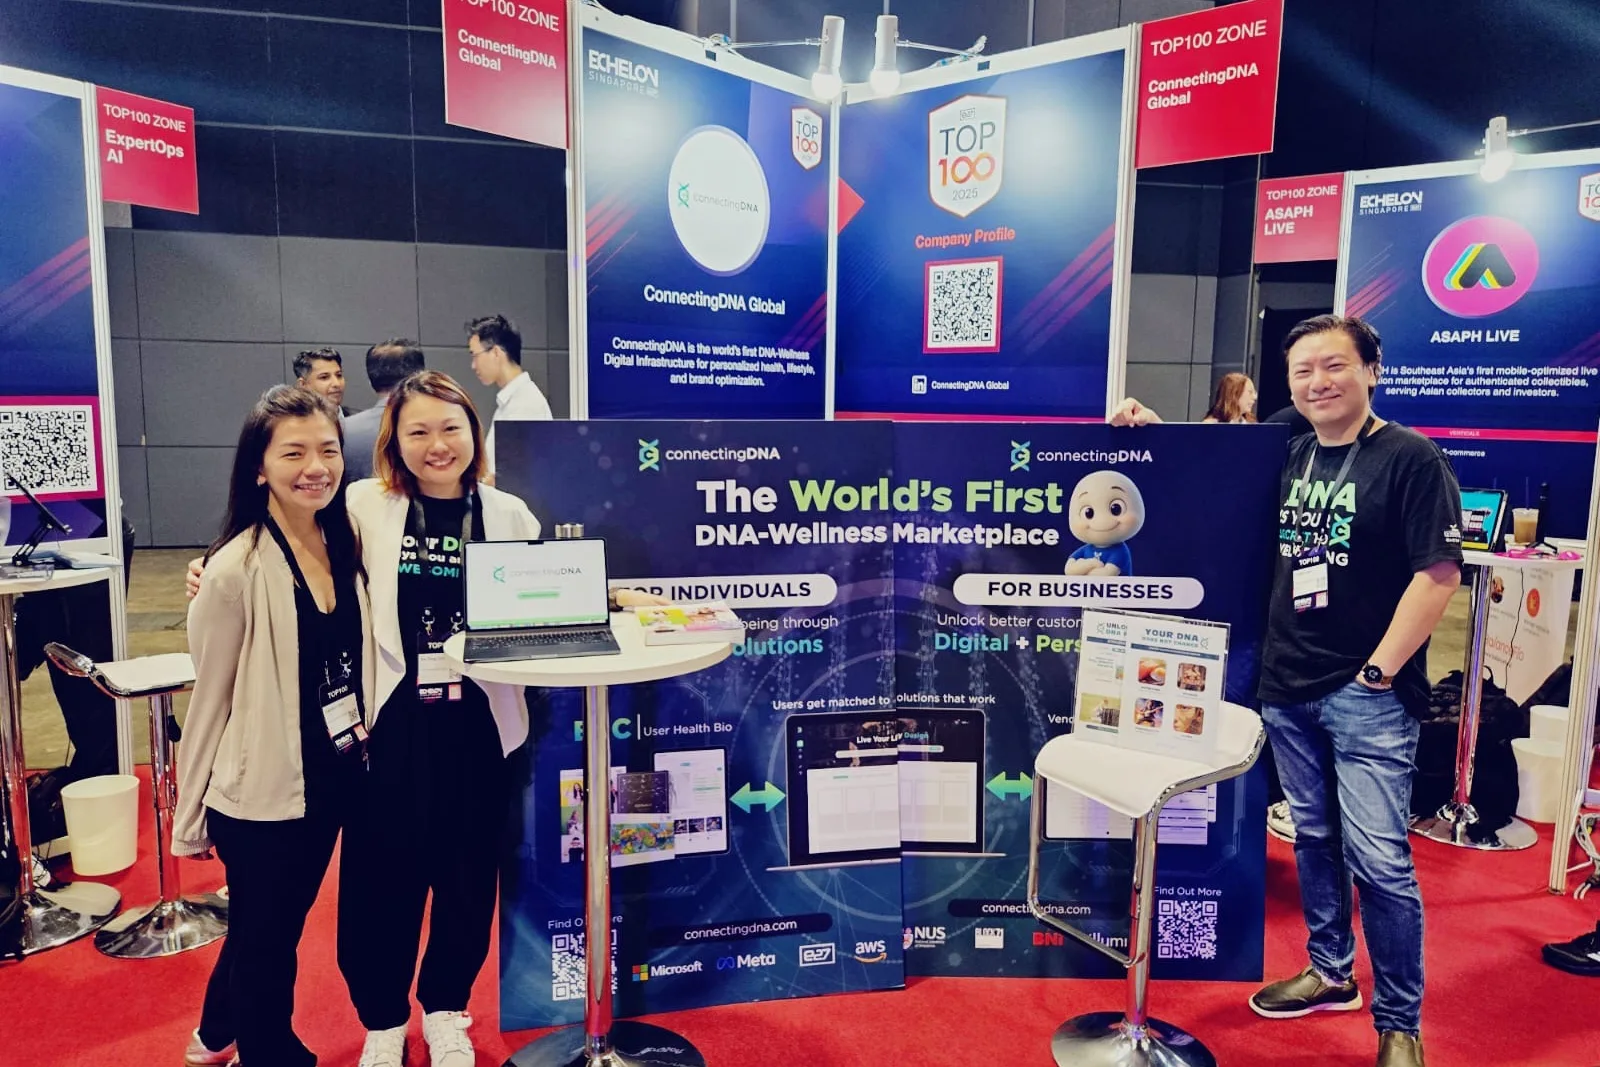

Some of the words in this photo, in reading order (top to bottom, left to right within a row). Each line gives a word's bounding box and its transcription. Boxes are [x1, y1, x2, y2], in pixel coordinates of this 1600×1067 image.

[518, 4, 560, 32] ZONE
[1150, 31, 1212, 56] TOP100
[1215, 19, 1267, 44] ZONE
[458, 28, 557, 70] ConnectingDNA
[459, 48, 501, 71] Global
[588, 49, 659, 88] ECHELON
[1148, 62, 1259, 93] ConnectingDNA
[1147, 91, 1191, 110] Global
[103, 103, 150, 125] TOP100
[152, 114, 187, 133] ZONE
[796, 120, 819, 139] TOP
[939, 121, 996, 156] TOP
[104, 129, 185, 159] ExpertOps
[795, 135, 819, 155] 100
[106, 148, 124, 165] AI
[938, 152, 996, 187] 100
[952, 187, 979, 201] 2025
[1266, 188, 1305, 201] TOP100
[1306, 185, 1338, 198] ZONE
[1359, 190, 1423, 209] ECHELON
[1264, 205, 1314, 221] ASAPH
[1359, 205, 1409, 216] SINGAPORE
[915, 232, 972, 249] Company
[974, 226, 1016, 244] Profile
[1264, 222, 1296, 236] LIVE
[643, 284, 747, 312] ConnectingDNA
[748, 298, 786, 315] Global
[1430, 330, 1482, 343] ASAPH
[1485, 329, 1521, 343] LIVE
[612, 336, 687, 355] ConnectingDNA
[687, 342, 696, 353] is
[697, 342, 711, 354] the
[712, 344, 742, 357] world's
[742, 344, 758, 358] first
[758, 345, 810, 360] DNA-Wellness
[603, 353, 634, 368] Digital
[635, 354, 696, 369] Infrastructure
[696, 357, 709, 370] for
[709, 358, 760, 373] personalized
[760, 361, 786, 374] health,
[786, 362, 816, 376] lifestyle,
[1390, 366, 1399, 375] is
[1400, 366, 1445, 375] Southeast
[1446, 366, 1475, 375] Asia's
[1476, 366, 1495, 375] first
[1496, 366, 1579, 377] mobile-optimized
[1580, 366, 1598, 376] live
[670, 372, 688, 384] and
[688, 372, 714, 385] brand
[715, 373, 765, 388] optimization.
[931, 380, 985, 391] ConnectingDNA
[985, 380, 1010, 390] Global
[1395, 376, 1449, 386] marketplace
[1451, 376, 1463, 385] for
[1465, 376, 1530, 386] authenticated
[1531, 377, 1589, 387] collectibles,
[1385, 387, 1418, 397] serving
[1419, 387, 1444, 396] Asian
[1446, 387, 1491, 396] collectors
[1492, 387, 1511, 396] and
[1513, 387, 1559, 397] investors.
[665, 446, 781, 462] connectingDNA
[1036, 449, 1153, 464] connectingDNA
[696, 479, 778, 514] The
[789, 477, 953, 513] World's
[965, 480, 1063, 514] First
[695, 521, 888, 547] DNA-Wellness
[892, 522, 1060, 549] Marketplace
[670, 582, 812, 601] INDIVIDUALS
[987, 581, 1033, 598] FOR
[1038, 582, 1174, 600] BUSINESSES
[783, 615, 839, 630] through
[936, 613, 985, 627] Unlock
[989, 614, 1033, 628] better
[934, 632, 1009, 655] Digital
[1145, 628, 1174, 639] YOUR
[1176, 632, 1199, 642] DNA
[772, 700, 804, 711] Users
[806, 699, 825, 710] get
[828, 696, 876, 708] matched
[878, 696, 890, 706] to
[942, 693, 966, 704] that
[968, 694, 996, 705] work
[643, 725, 670, 737] User
[673, 723, 711, 735] Health
[713, 721, 733, 733] Bio
[856, 736, 872, 744] Live
[873, 735, 890, 743] Your
[1155, 886, 1174, 896] Find
[1177, 887, 1196, 896] Out
[1197, 887, 1222, 897] More
[981, 903, 1092, 916] connectidna.com
[547, 918, 572, 929] Find
[684, 918, 798, 940] connectingdna.com
[651, 960, 704, 978] Microsoft
[736, 952, 776, 970] Meta
[854, 939, 886, 955] aws
[914, 926, 946, 940] NUS
